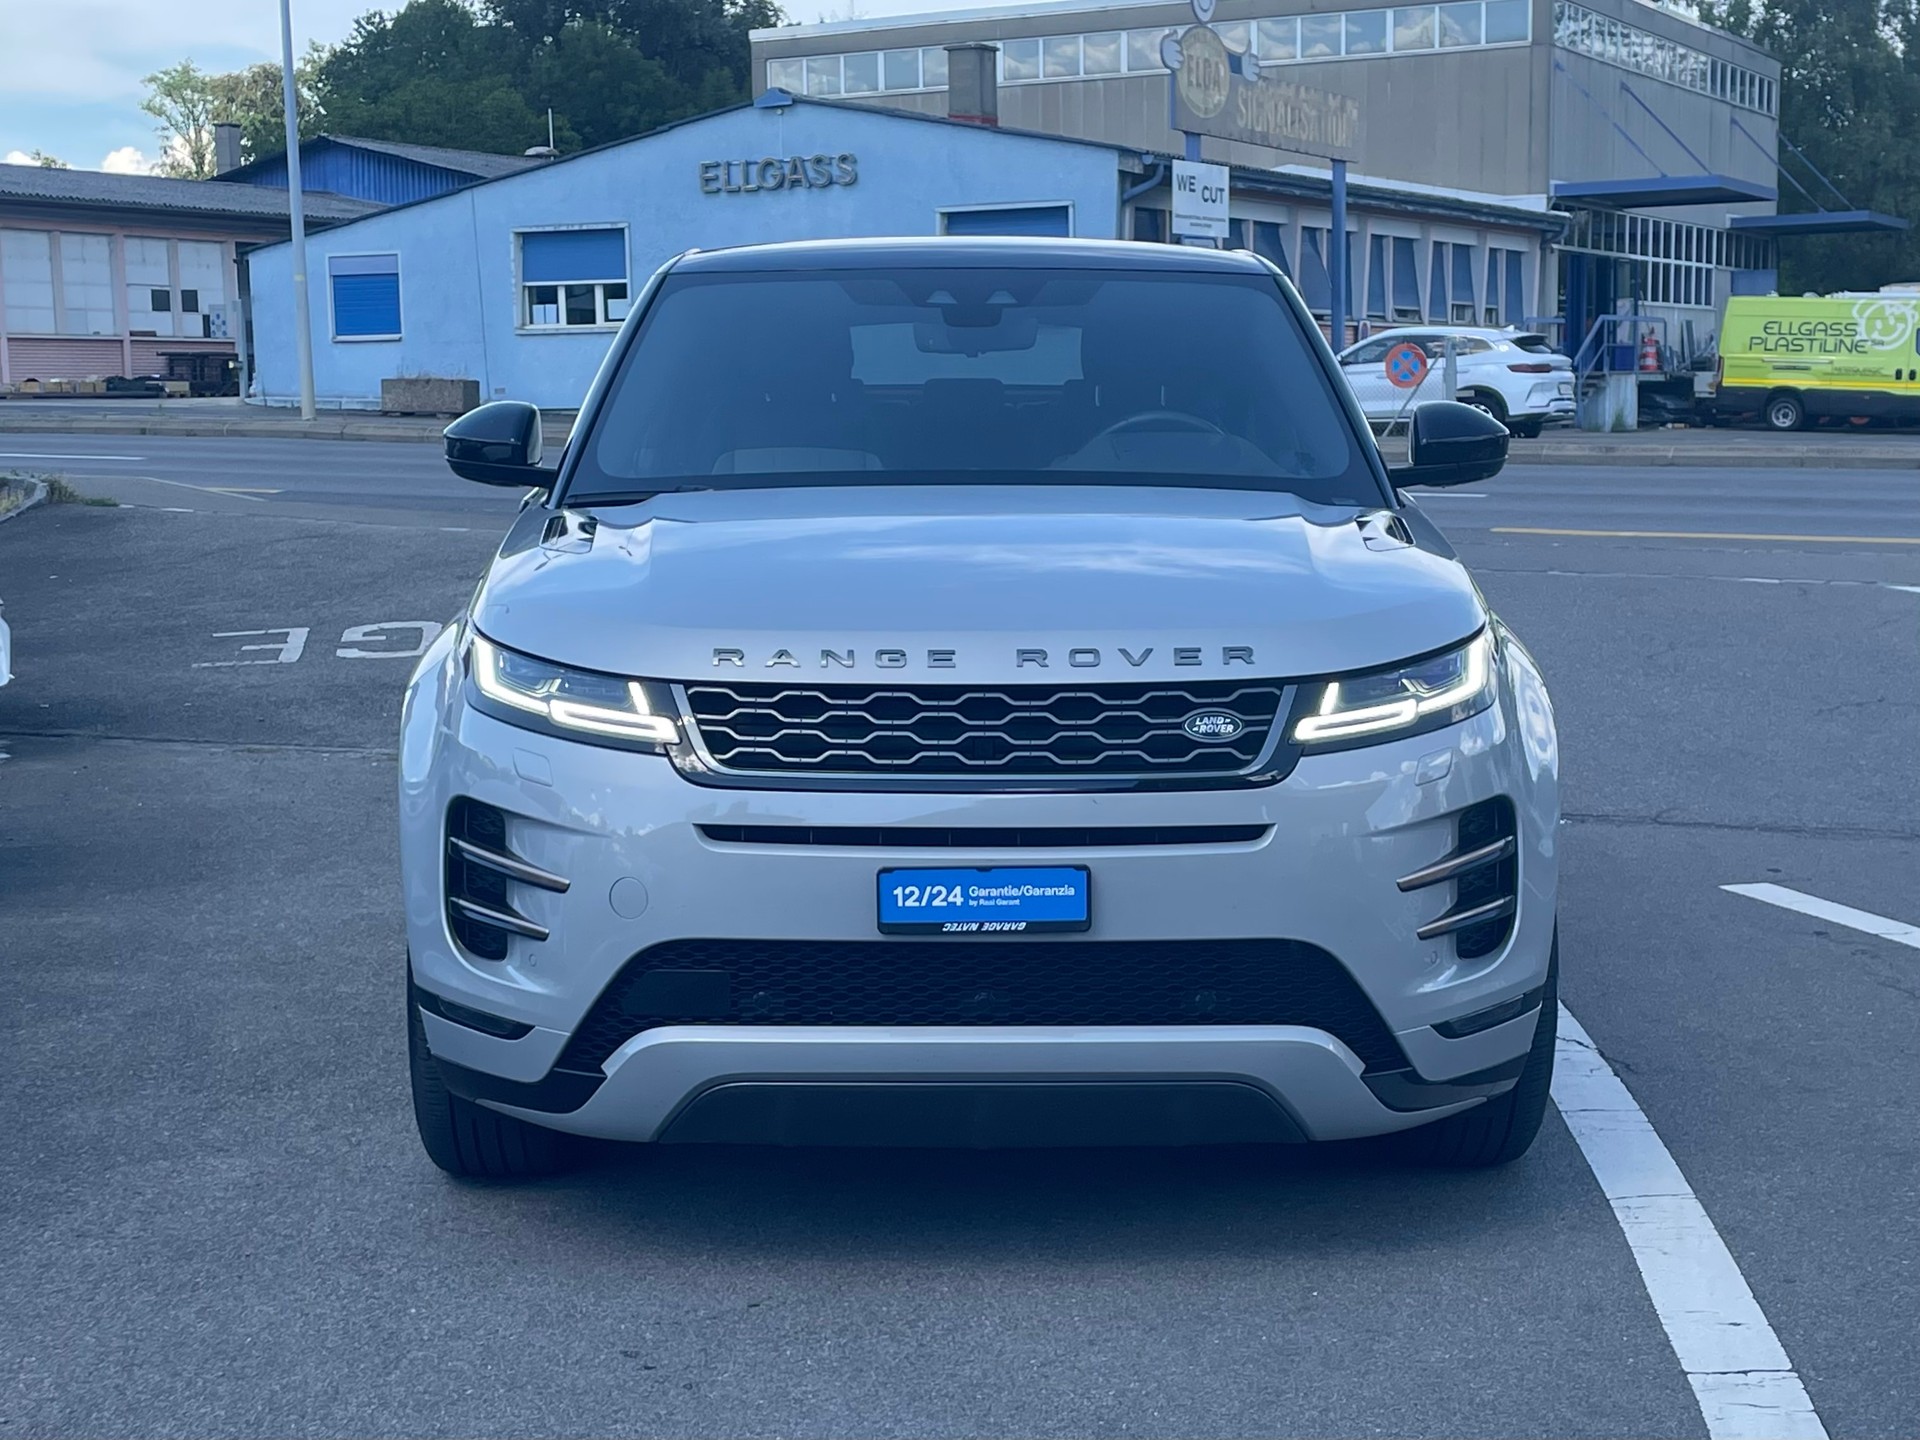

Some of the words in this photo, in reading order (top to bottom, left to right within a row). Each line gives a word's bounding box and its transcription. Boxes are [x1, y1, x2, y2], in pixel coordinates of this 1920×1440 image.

[700, 153, 858, 194] ELLGASS
[1176, 173, 1196, 193] WE
[1202, 186, 1225, 203] CUT
[1763, 321, 1858, 337] ELLGASS
[712, 648, 957, 668] RANGE
[1016, 646, 1256, 668] ROVER
[1195, 716, 1224, 725] LAND
[1199, 724, 1234, 733] ROVER
[893, 885, 964, 907] 12/24
[969, 884, 1075, 897] Garantie/Garanzia
[942, 922, 979, 931] NATEC
[981, 921, 1026, 931] GARAGE
